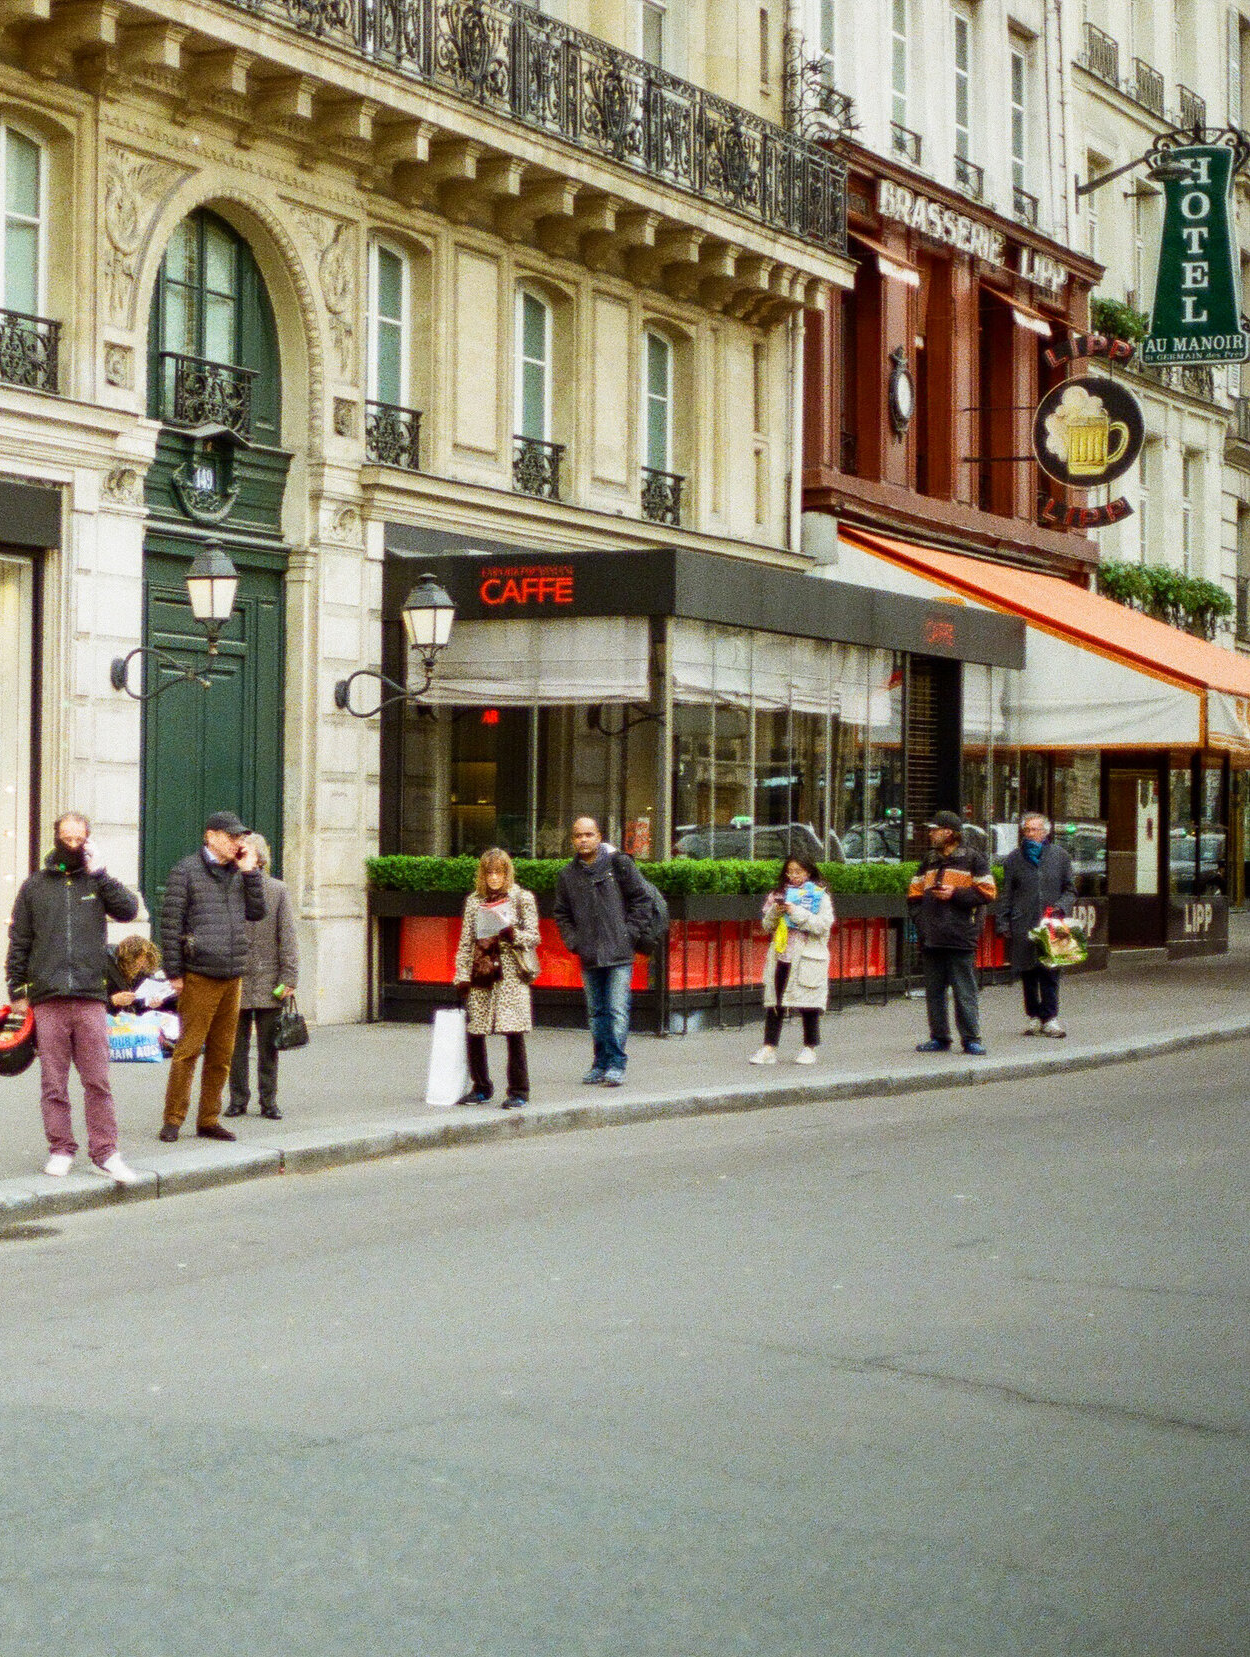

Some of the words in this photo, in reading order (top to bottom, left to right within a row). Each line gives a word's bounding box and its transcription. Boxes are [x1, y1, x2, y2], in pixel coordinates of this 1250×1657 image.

[878, 178, 1006, 266] BRASSERIE
[1021, 246, 1068, 291] LIPP
[1180, 157, 1212, 323] HOTEL
[1045, 329, 1132, 368] LIPP
[1145, 338, 1168, 353] AU
[1173, 334, 1243, 352] MANOIR
[1156, 352, 1203, 361] GERMAIN
[1042, 498, 1126, 526] LIPP
[1185, 902, 1213, 932] LIPP
